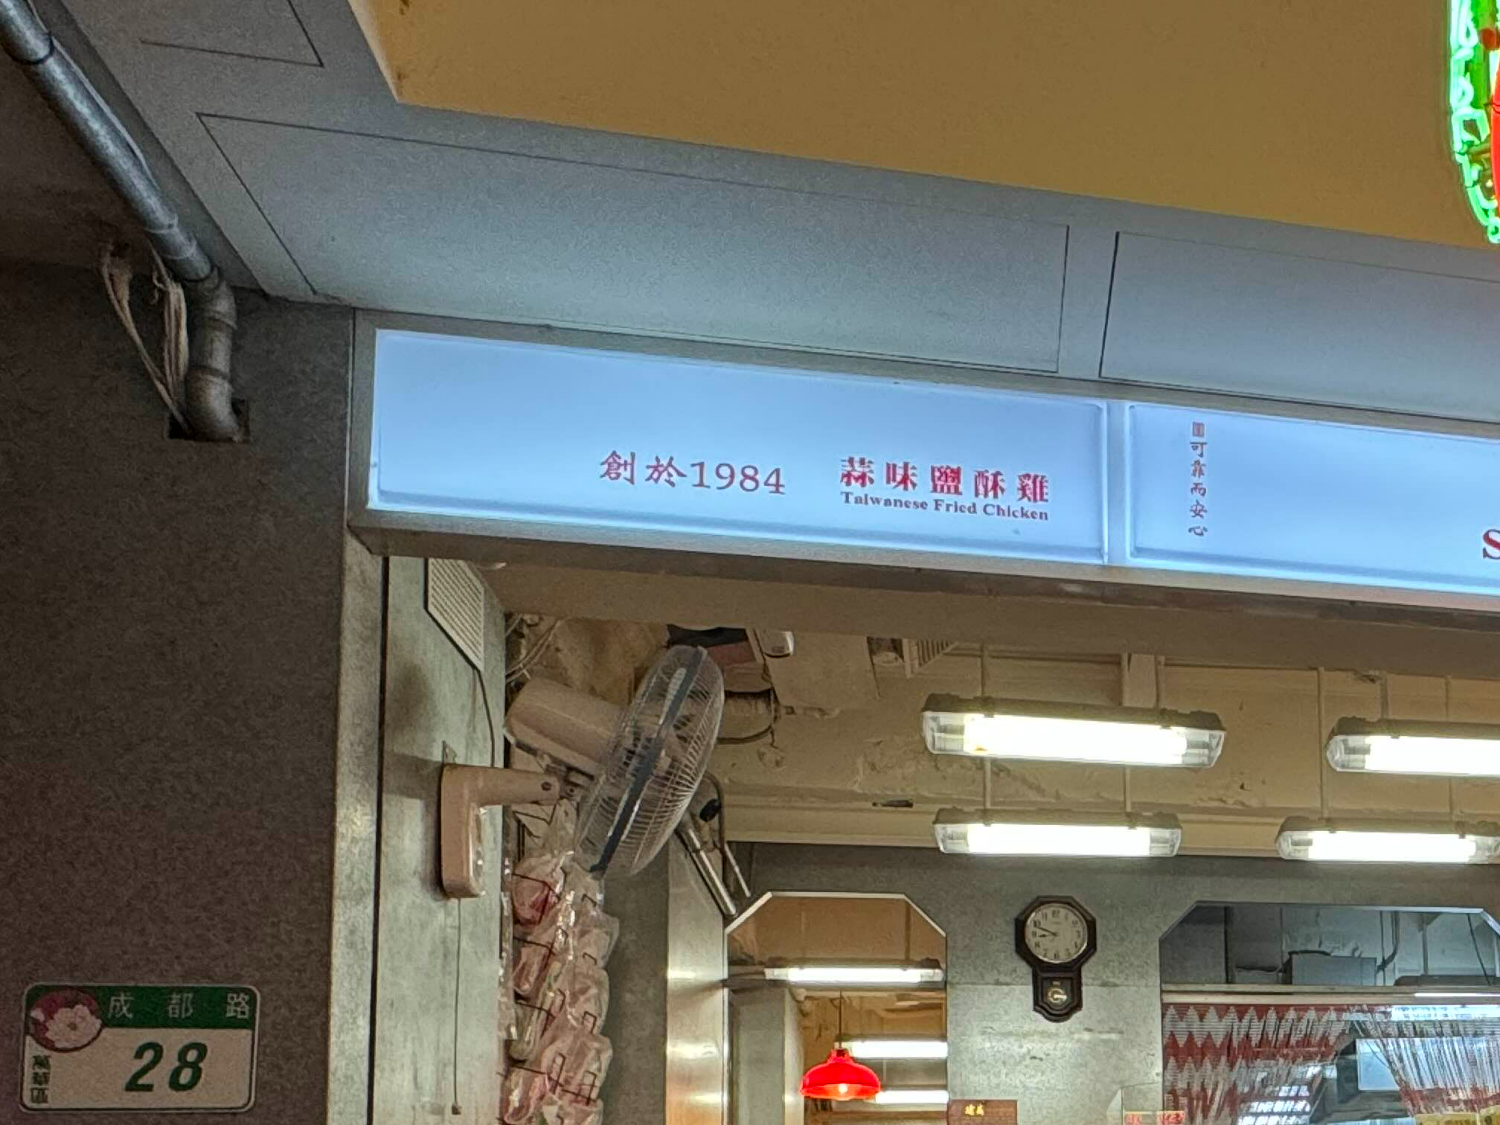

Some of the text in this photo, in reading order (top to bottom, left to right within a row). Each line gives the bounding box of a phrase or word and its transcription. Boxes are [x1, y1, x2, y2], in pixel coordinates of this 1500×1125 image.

[599, 450, 786, 495] 創於1984
[840, 457, 1050, 504] 蒜味鹽酥雞
[841, 491, 1049, 522] Taiwanese Fried Chicken
[107, 991, 250, 1020] 成都路
[124, 1041, 209, 1093] 28
